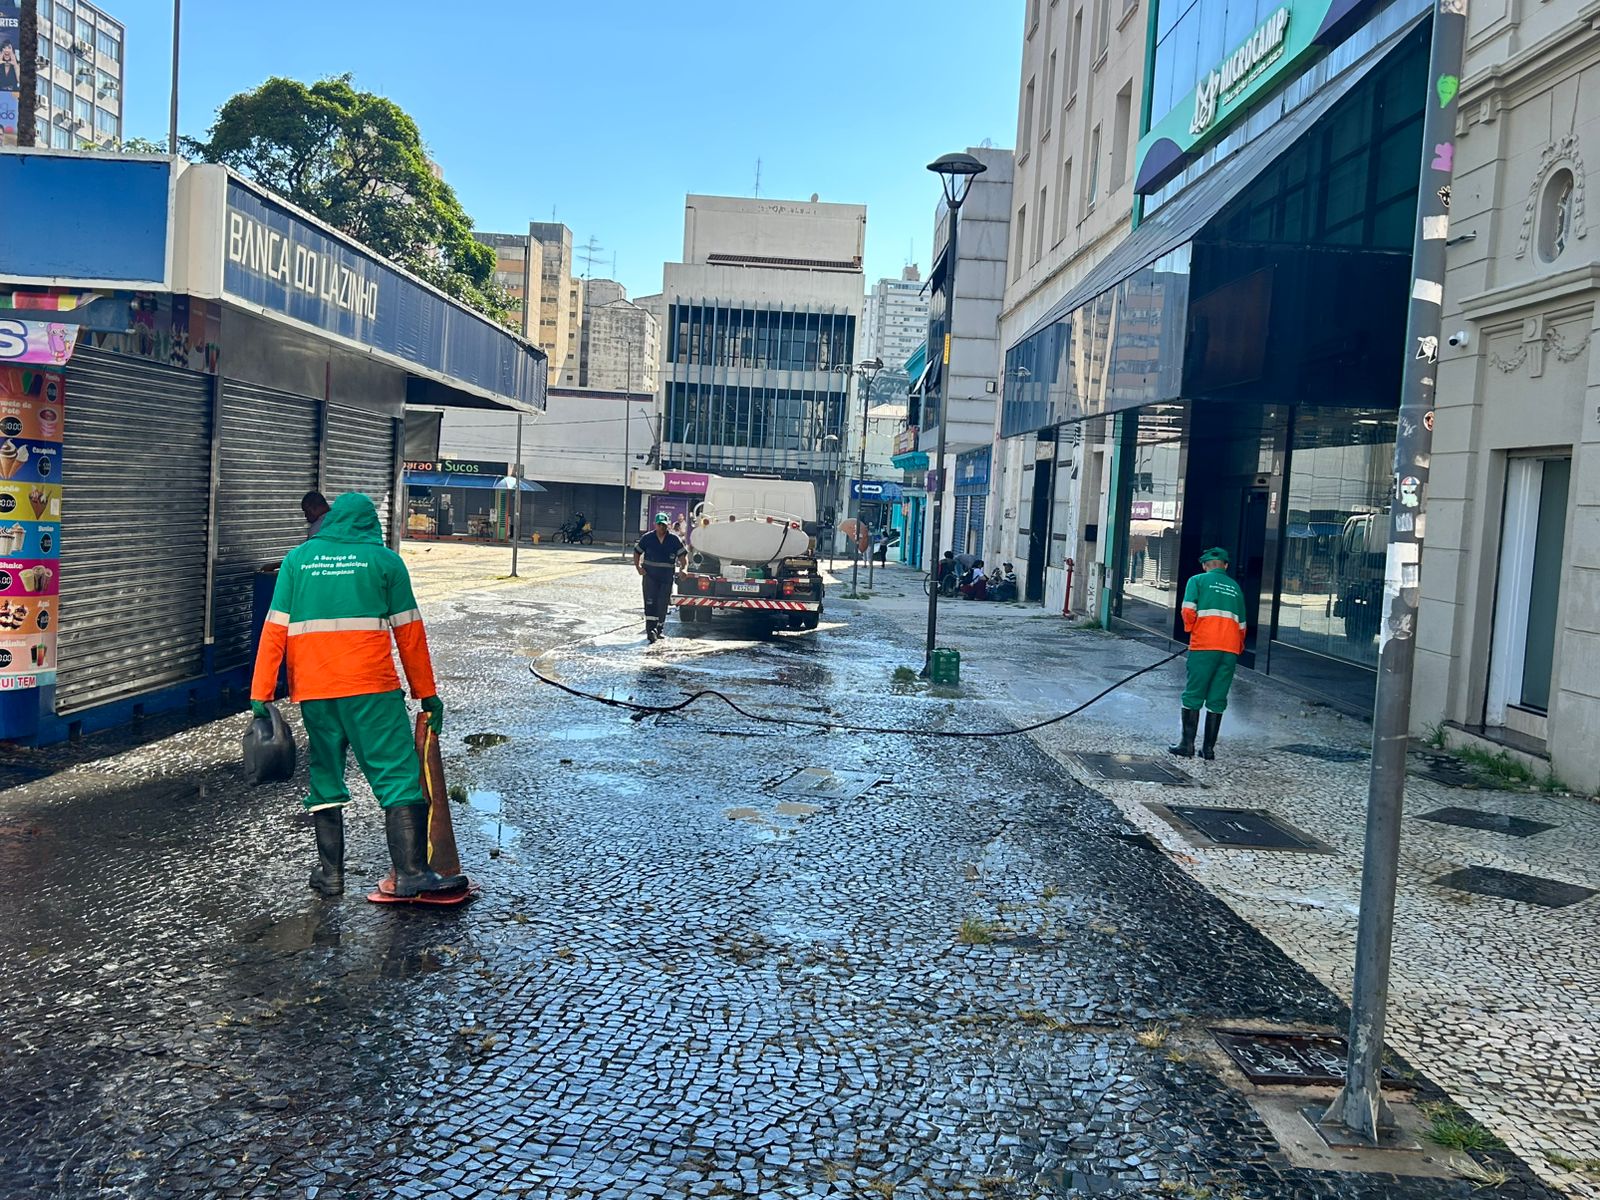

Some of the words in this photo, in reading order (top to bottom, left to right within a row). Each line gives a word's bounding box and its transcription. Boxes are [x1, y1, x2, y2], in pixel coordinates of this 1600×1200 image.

[1219, 7, 1288, 95] MICROCAMP
[229, 212, 290, 283] BANCA
[294, 245, 317, 294] DO
[320, 257, 378, 320] LAZINHO
[445, 460, 479, 472] Sucos
[17, 677, 36, 687] TEM
